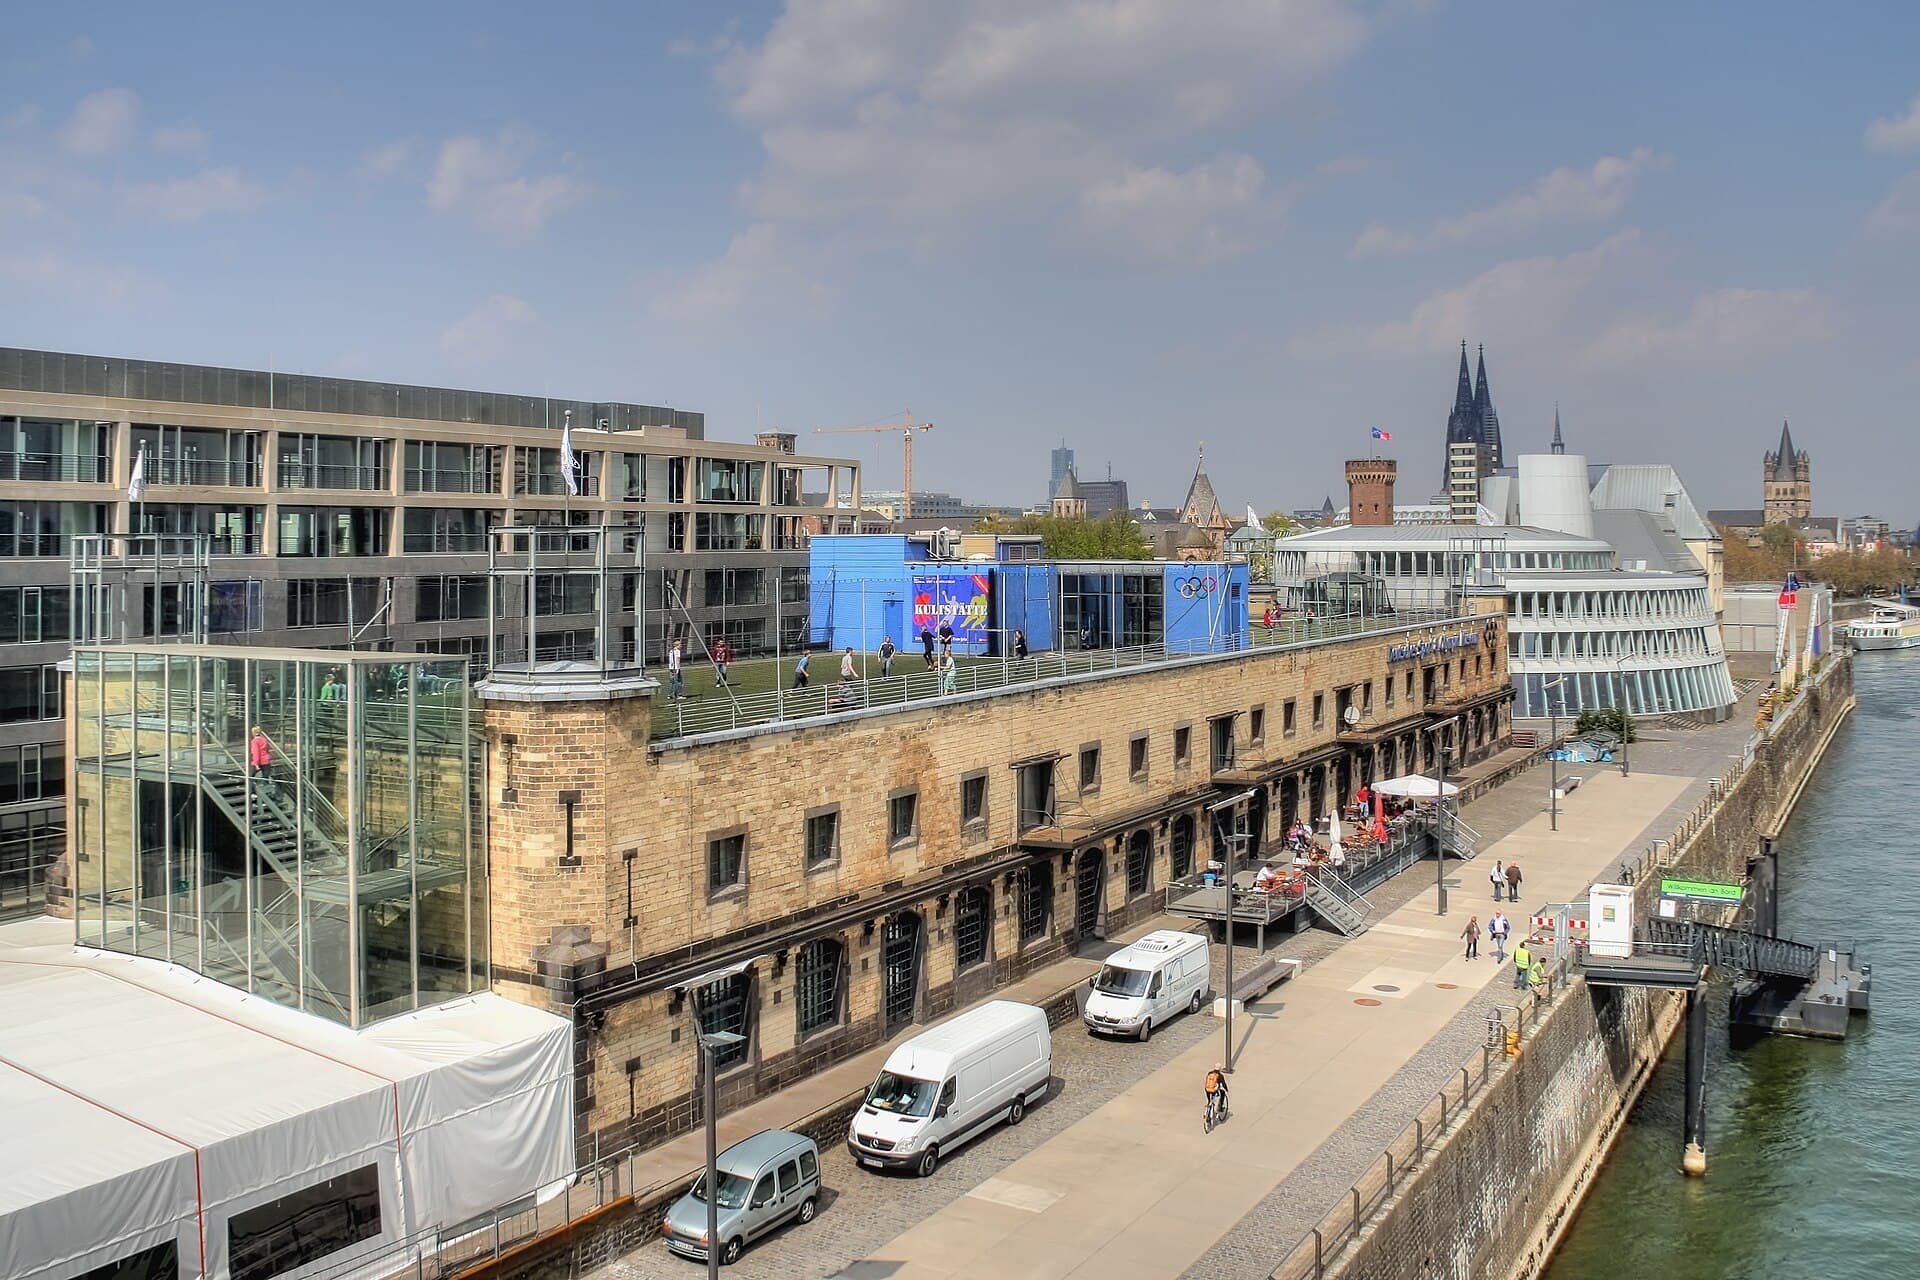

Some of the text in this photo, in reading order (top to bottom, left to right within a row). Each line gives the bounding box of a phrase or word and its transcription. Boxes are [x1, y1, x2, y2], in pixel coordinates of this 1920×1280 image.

[914, 602, 988, 616] KULTSTÄTTE
[1667, 883, 1707, 893] Willkommen
[1720, 888, 1736, 896] Bord
